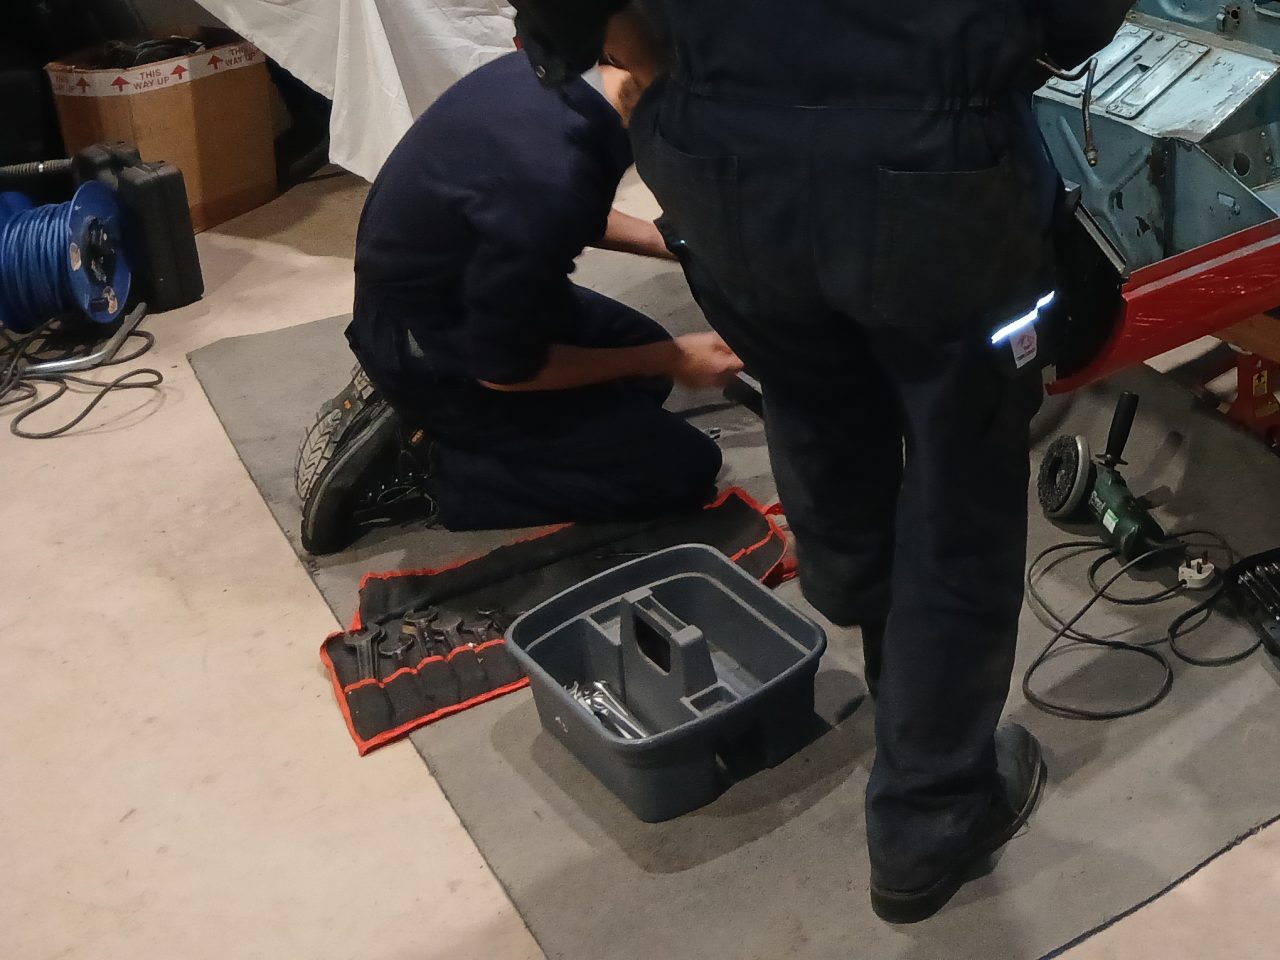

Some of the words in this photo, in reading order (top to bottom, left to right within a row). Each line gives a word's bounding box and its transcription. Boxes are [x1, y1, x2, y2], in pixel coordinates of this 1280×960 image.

[225, 57, 242, 67] WAY
[139, 68, 163, 81] THIS
[133, 79, 155, 91] WAY
[156, 76, 171, 87] UP
